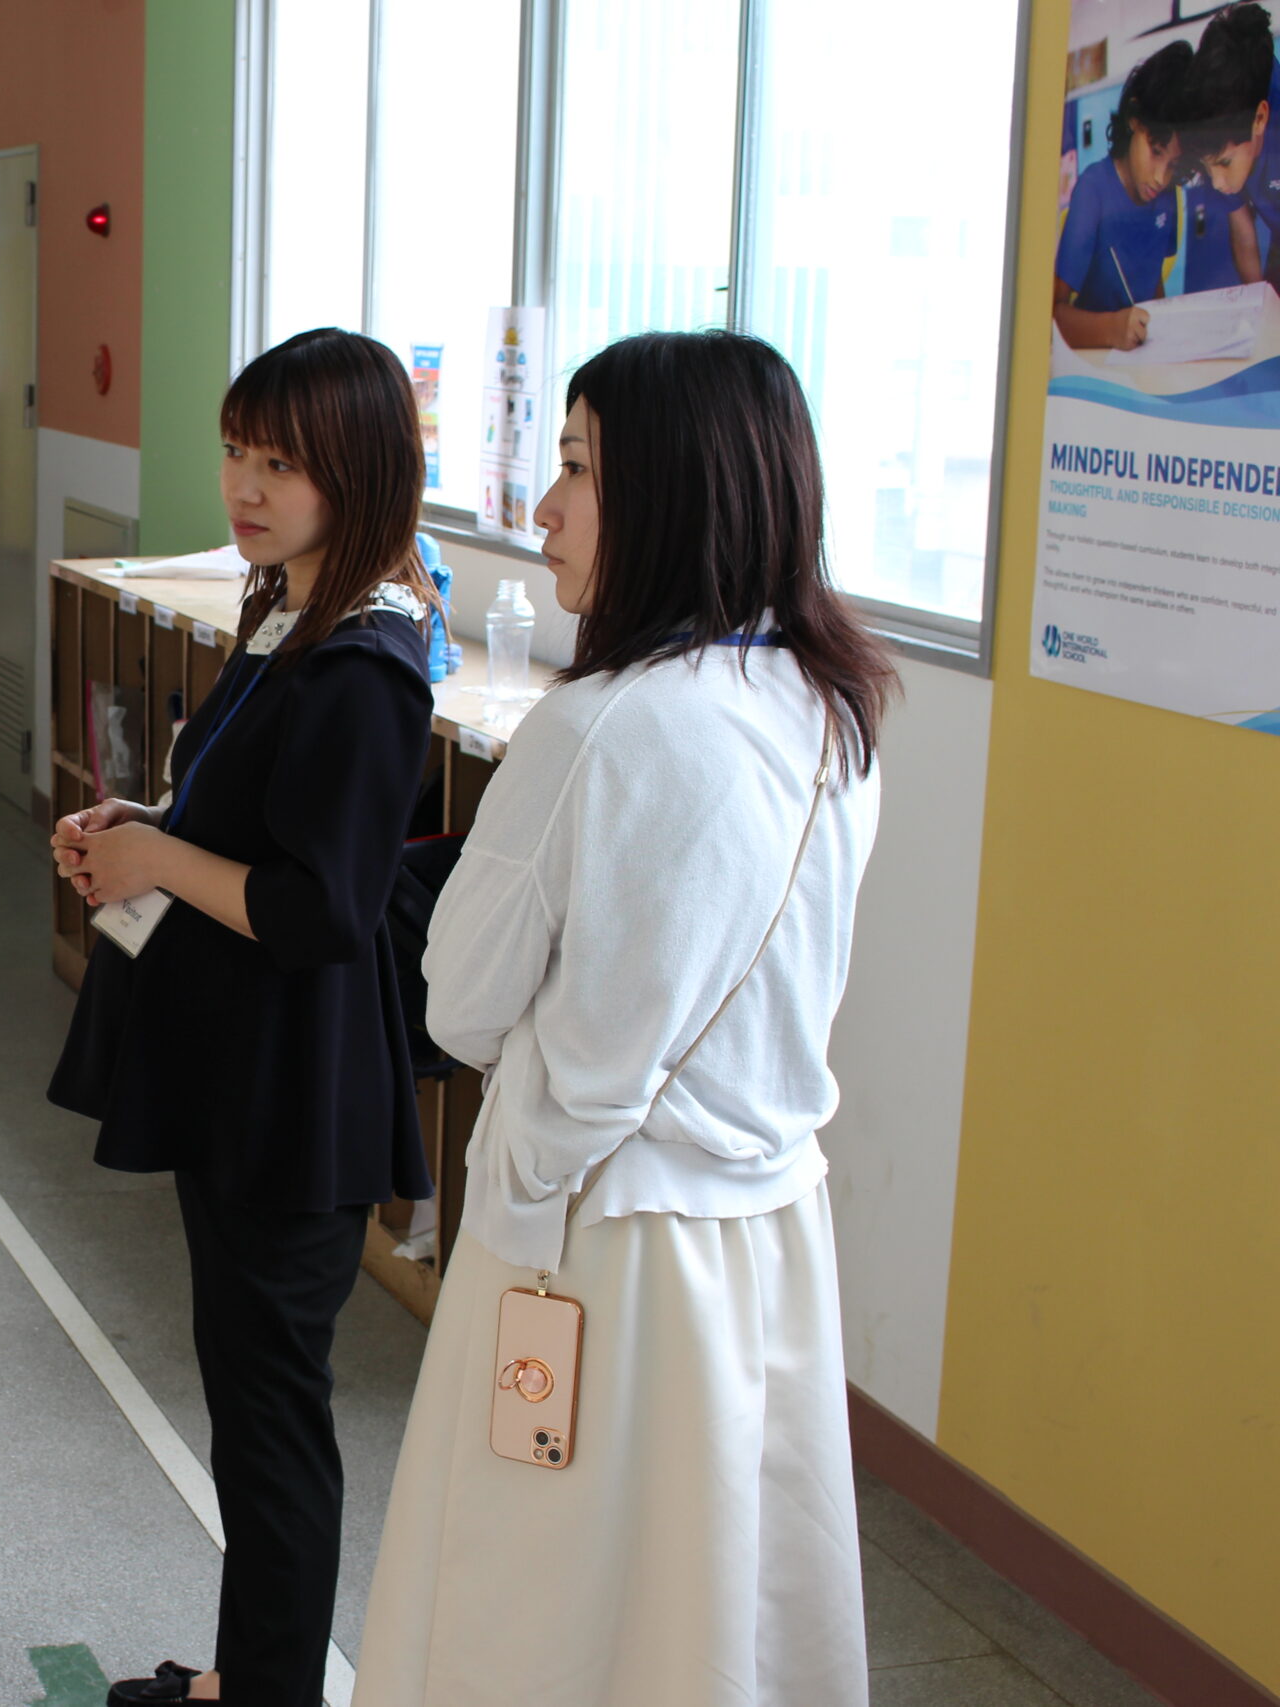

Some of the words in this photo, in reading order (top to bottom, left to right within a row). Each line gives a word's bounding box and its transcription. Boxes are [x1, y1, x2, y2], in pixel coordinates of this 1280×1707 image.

[1051, 443, 1139, 480] MINDFUL
[1147, 453, 1280, 496] INDEPENDE
[1050, 480, 1114, 501] THOUGHTFUL
[1117, 489, 1139, 505] AND
[1142, 492, 1220, 515] RESPONSIBLE
[1048, 500, 1087, 518] MAKING
[1220, 557, 1243, 569] develop
[1245, 561, 1259, 570] both
[1265, 607, 1277, 616] and
[1077, 634, 1099, 647] WORLD
